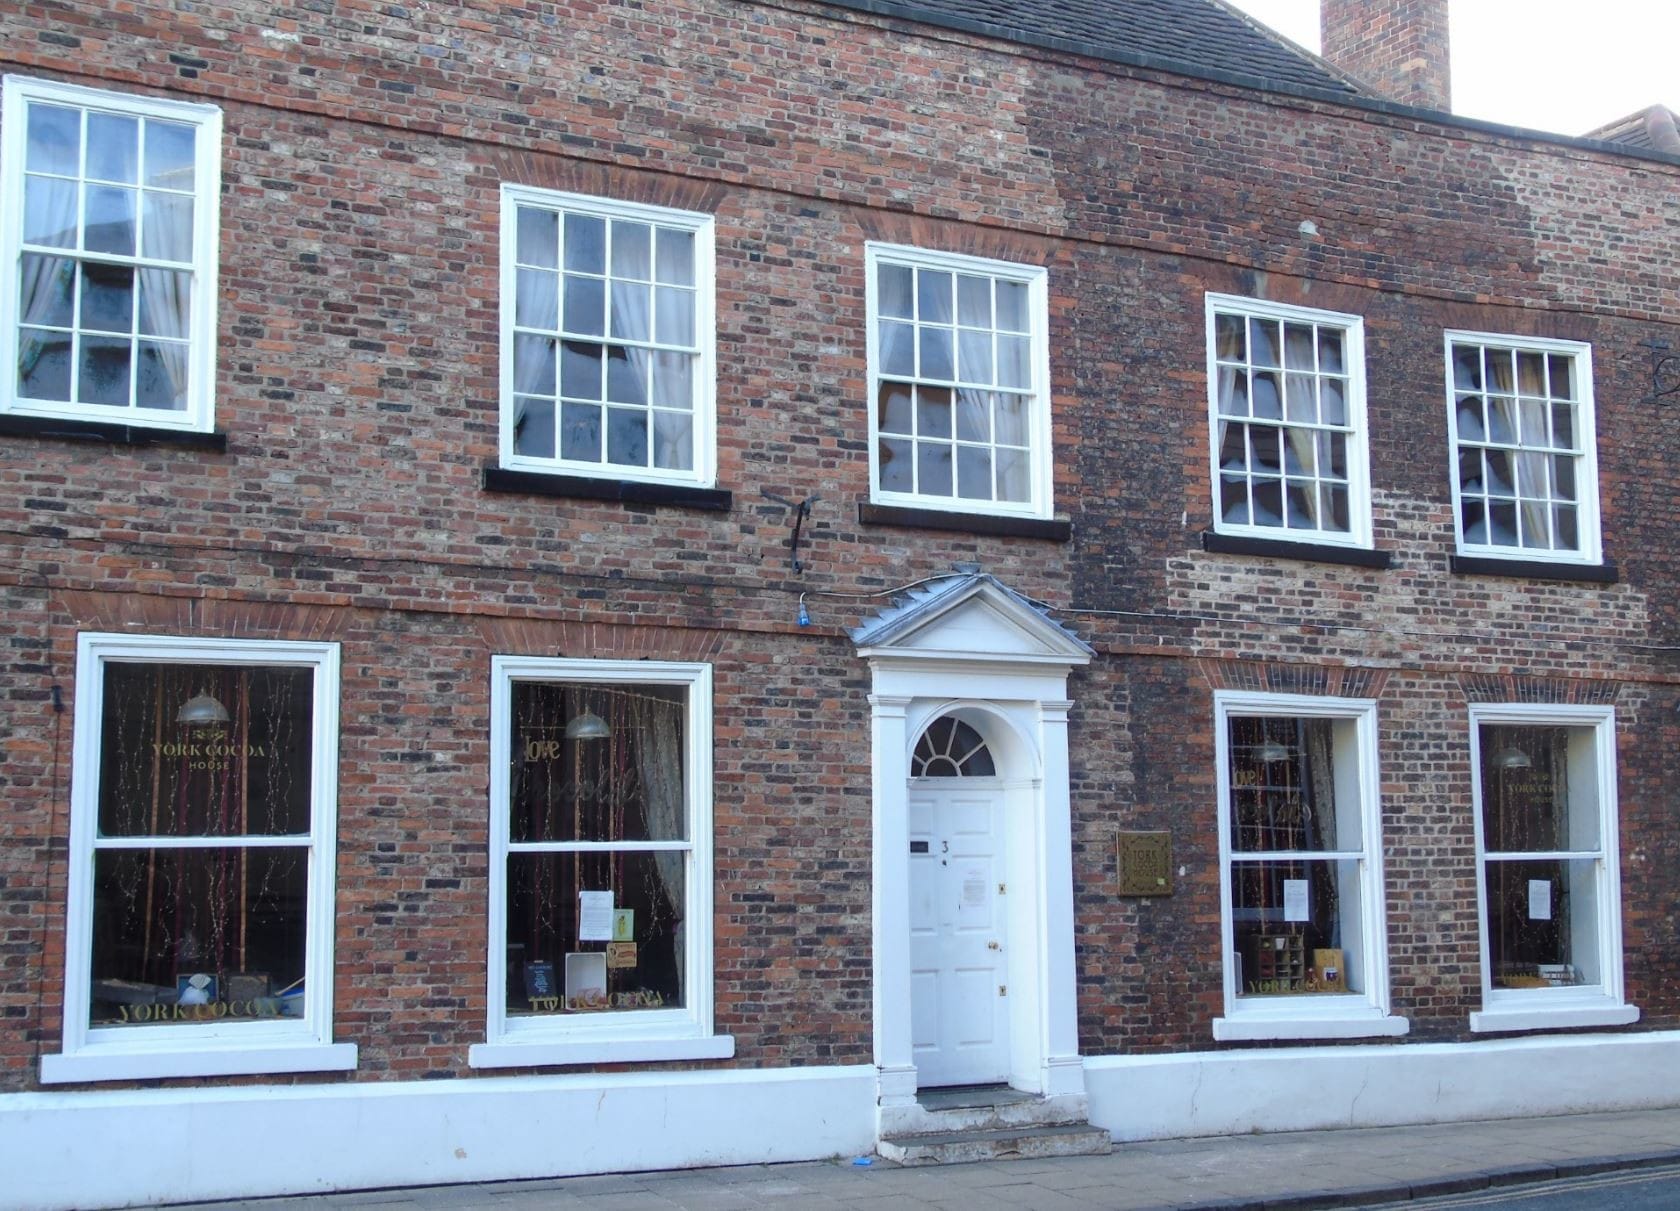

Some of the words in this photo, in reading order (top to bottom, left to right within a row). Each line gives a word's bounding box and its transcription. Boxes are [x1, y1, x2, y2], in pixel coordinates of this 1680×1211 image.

[152, 743, 201, 757] YORK
[205, 743, 265, 757] COCOA
[189, 761, 229, 770] HOUSE
[941, 840, 949, 854] 3
[119, 1003, 186, 1021] YORK
